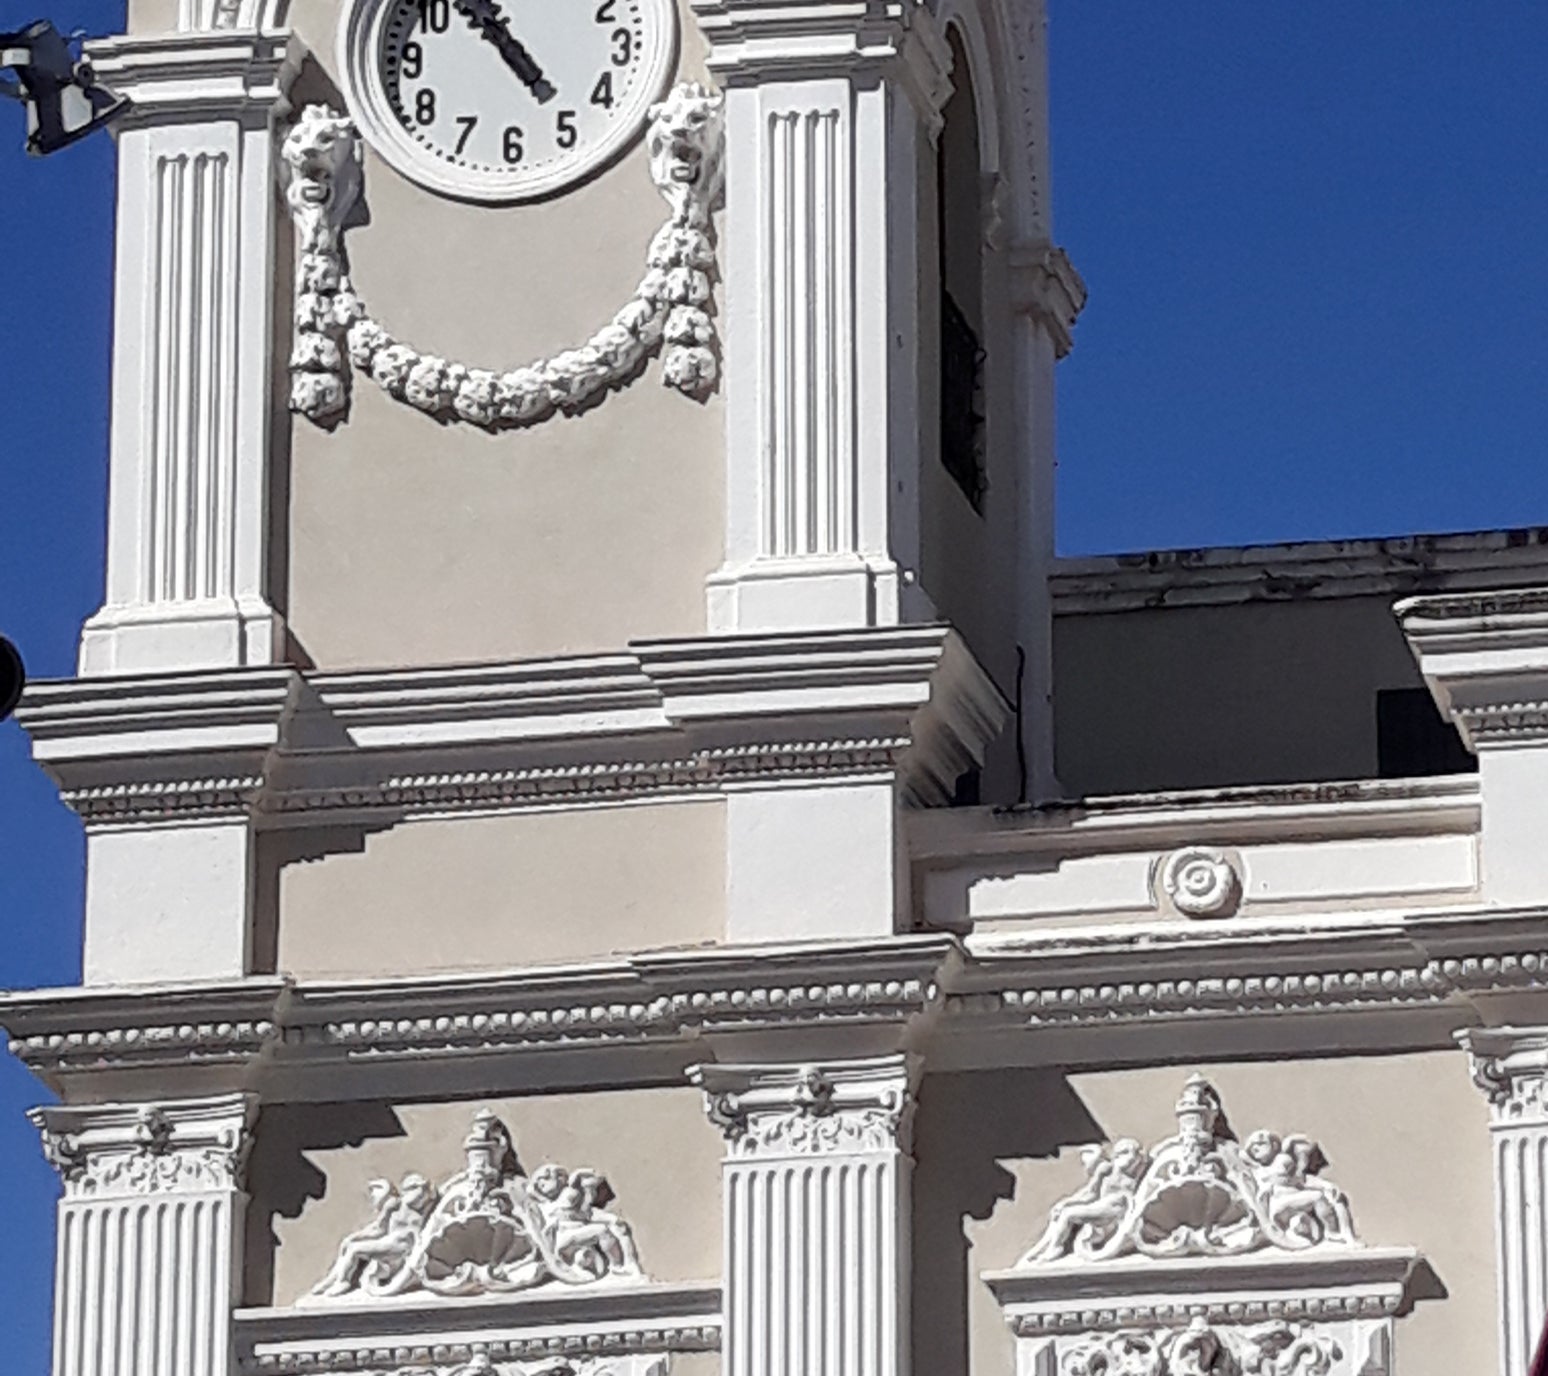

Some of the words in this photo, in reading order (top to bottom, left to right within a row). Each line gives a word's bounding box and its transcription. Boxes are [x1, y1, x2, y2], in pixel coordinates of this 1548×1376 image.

[401, 42, 423, 79] 9
[611, 28, 631, 66] 3
[415, 88, 436, 126] 8
[590, 71, 614, 110] 4
[456, 117, 478, 155] 7
[503, 126, 523, 164] 6
[556, 111, 577, 149] 5
